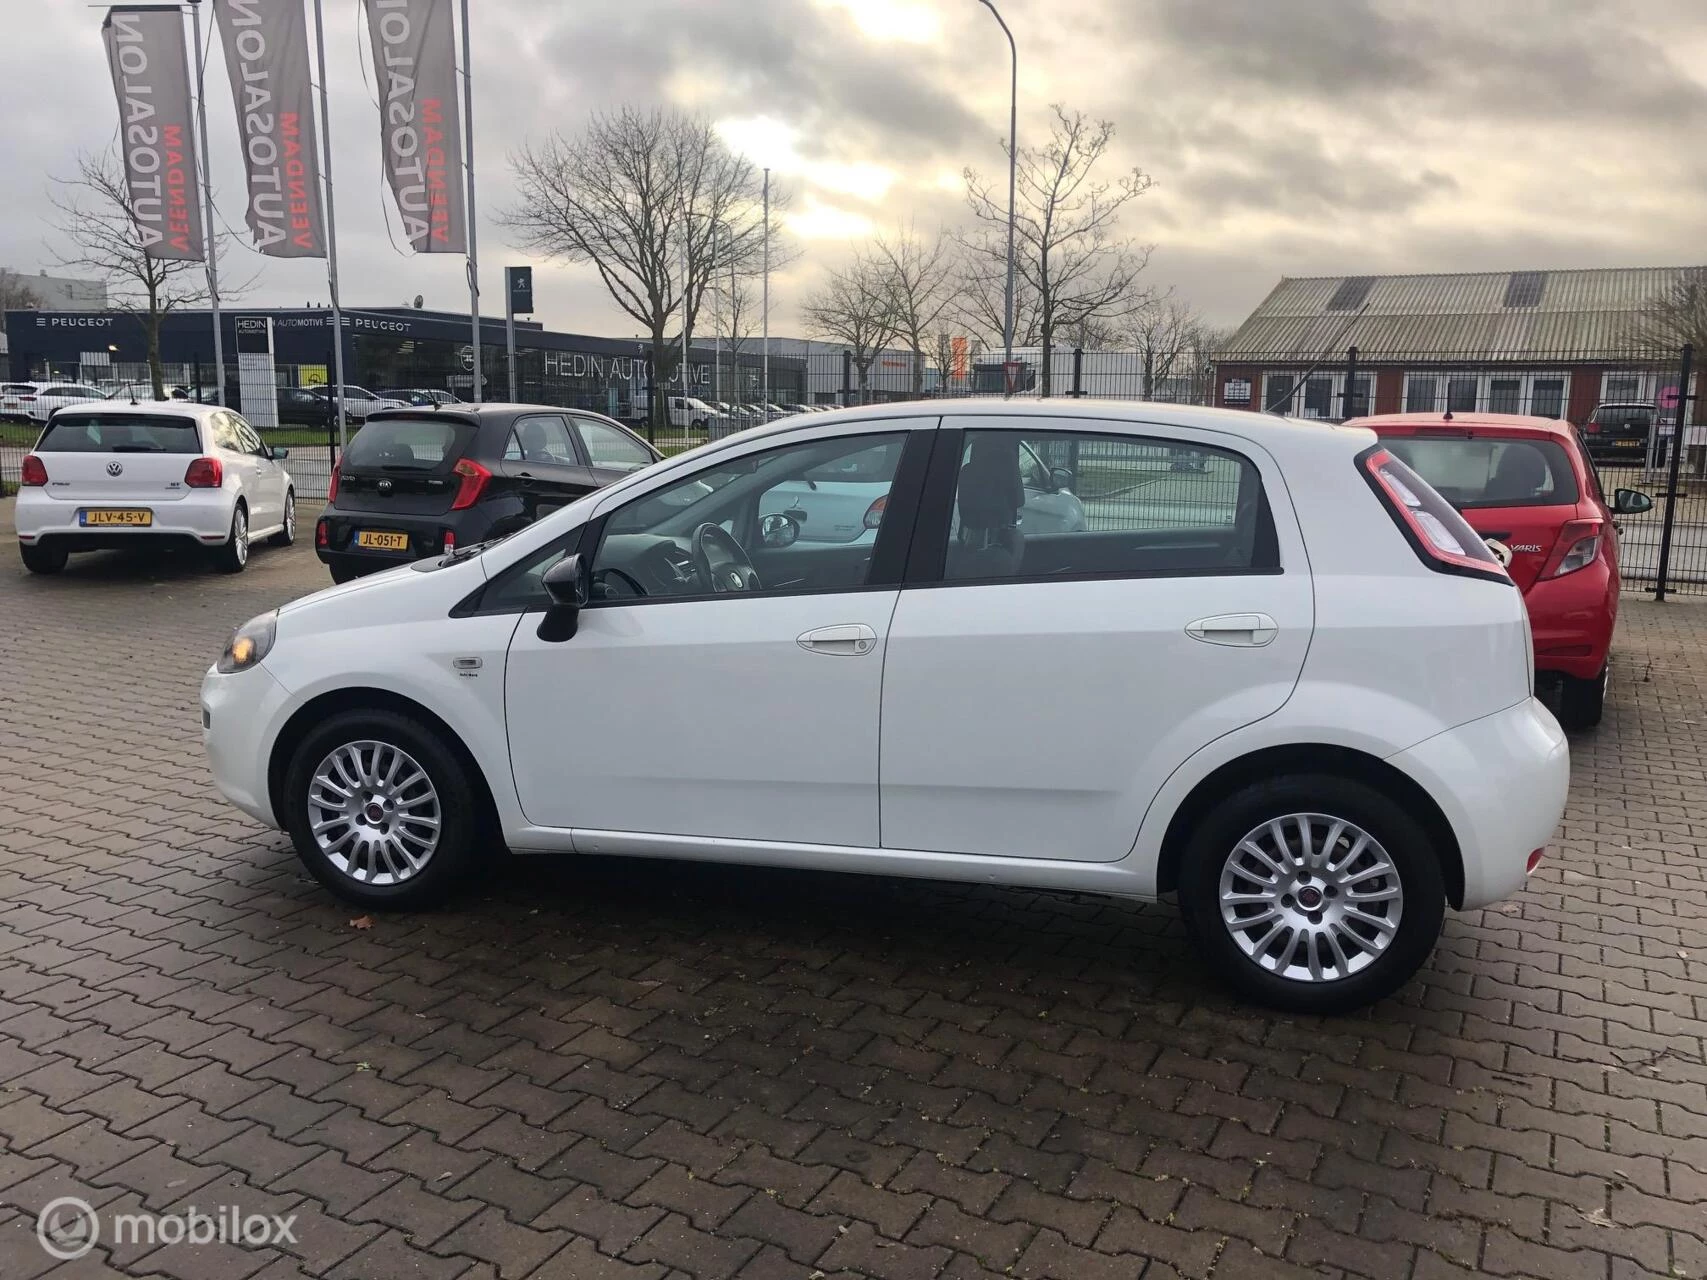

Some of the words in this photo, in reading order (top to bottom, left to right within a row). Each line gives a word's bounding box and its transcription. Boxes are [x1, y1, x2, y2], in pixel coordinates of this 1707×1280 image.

[51, 317, 113, 327] PEUGEOT
[237, 319, 266, 329] HEDIN
[277, 318, 324, 327] AUTOMOTIVE
[355, 318, 412, 332] PEUGEOT
[544, 350, 604, 379] HEDIN
[92, 512, 146, 523] JLV-45-V
[363, 533, 403, 547] JL-051-T
[1510, 544, 1542, 553] YARIS
